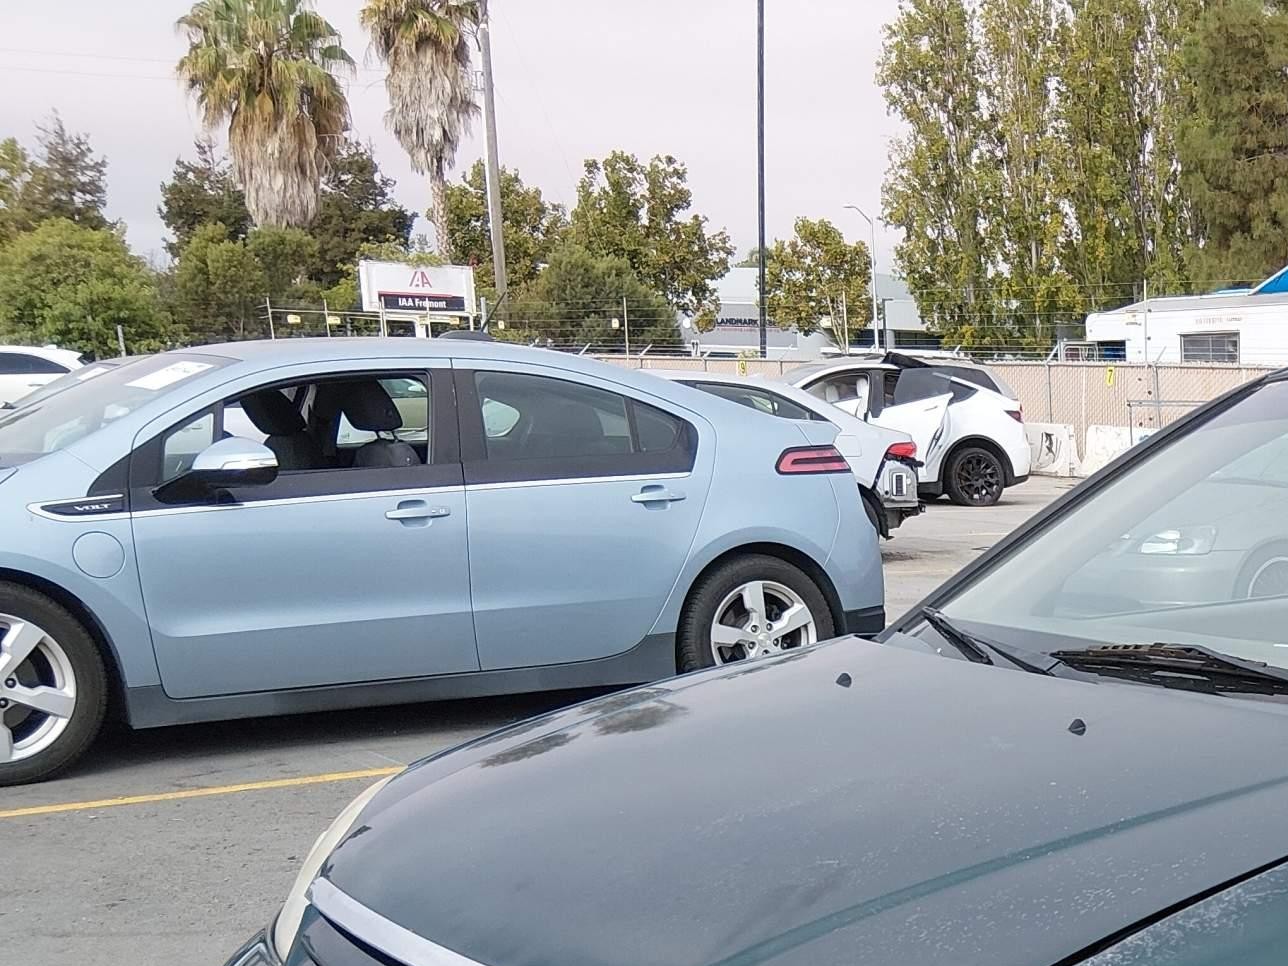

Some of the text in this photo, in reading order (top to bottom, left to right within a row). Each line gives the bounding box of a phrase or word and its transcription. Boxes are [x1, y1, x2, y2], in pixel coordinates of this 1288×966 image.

[398, 297, 414, 307] IAA
[1108, 369, 1113, 383] 7
[73, 503, 112, 512] VOLT
